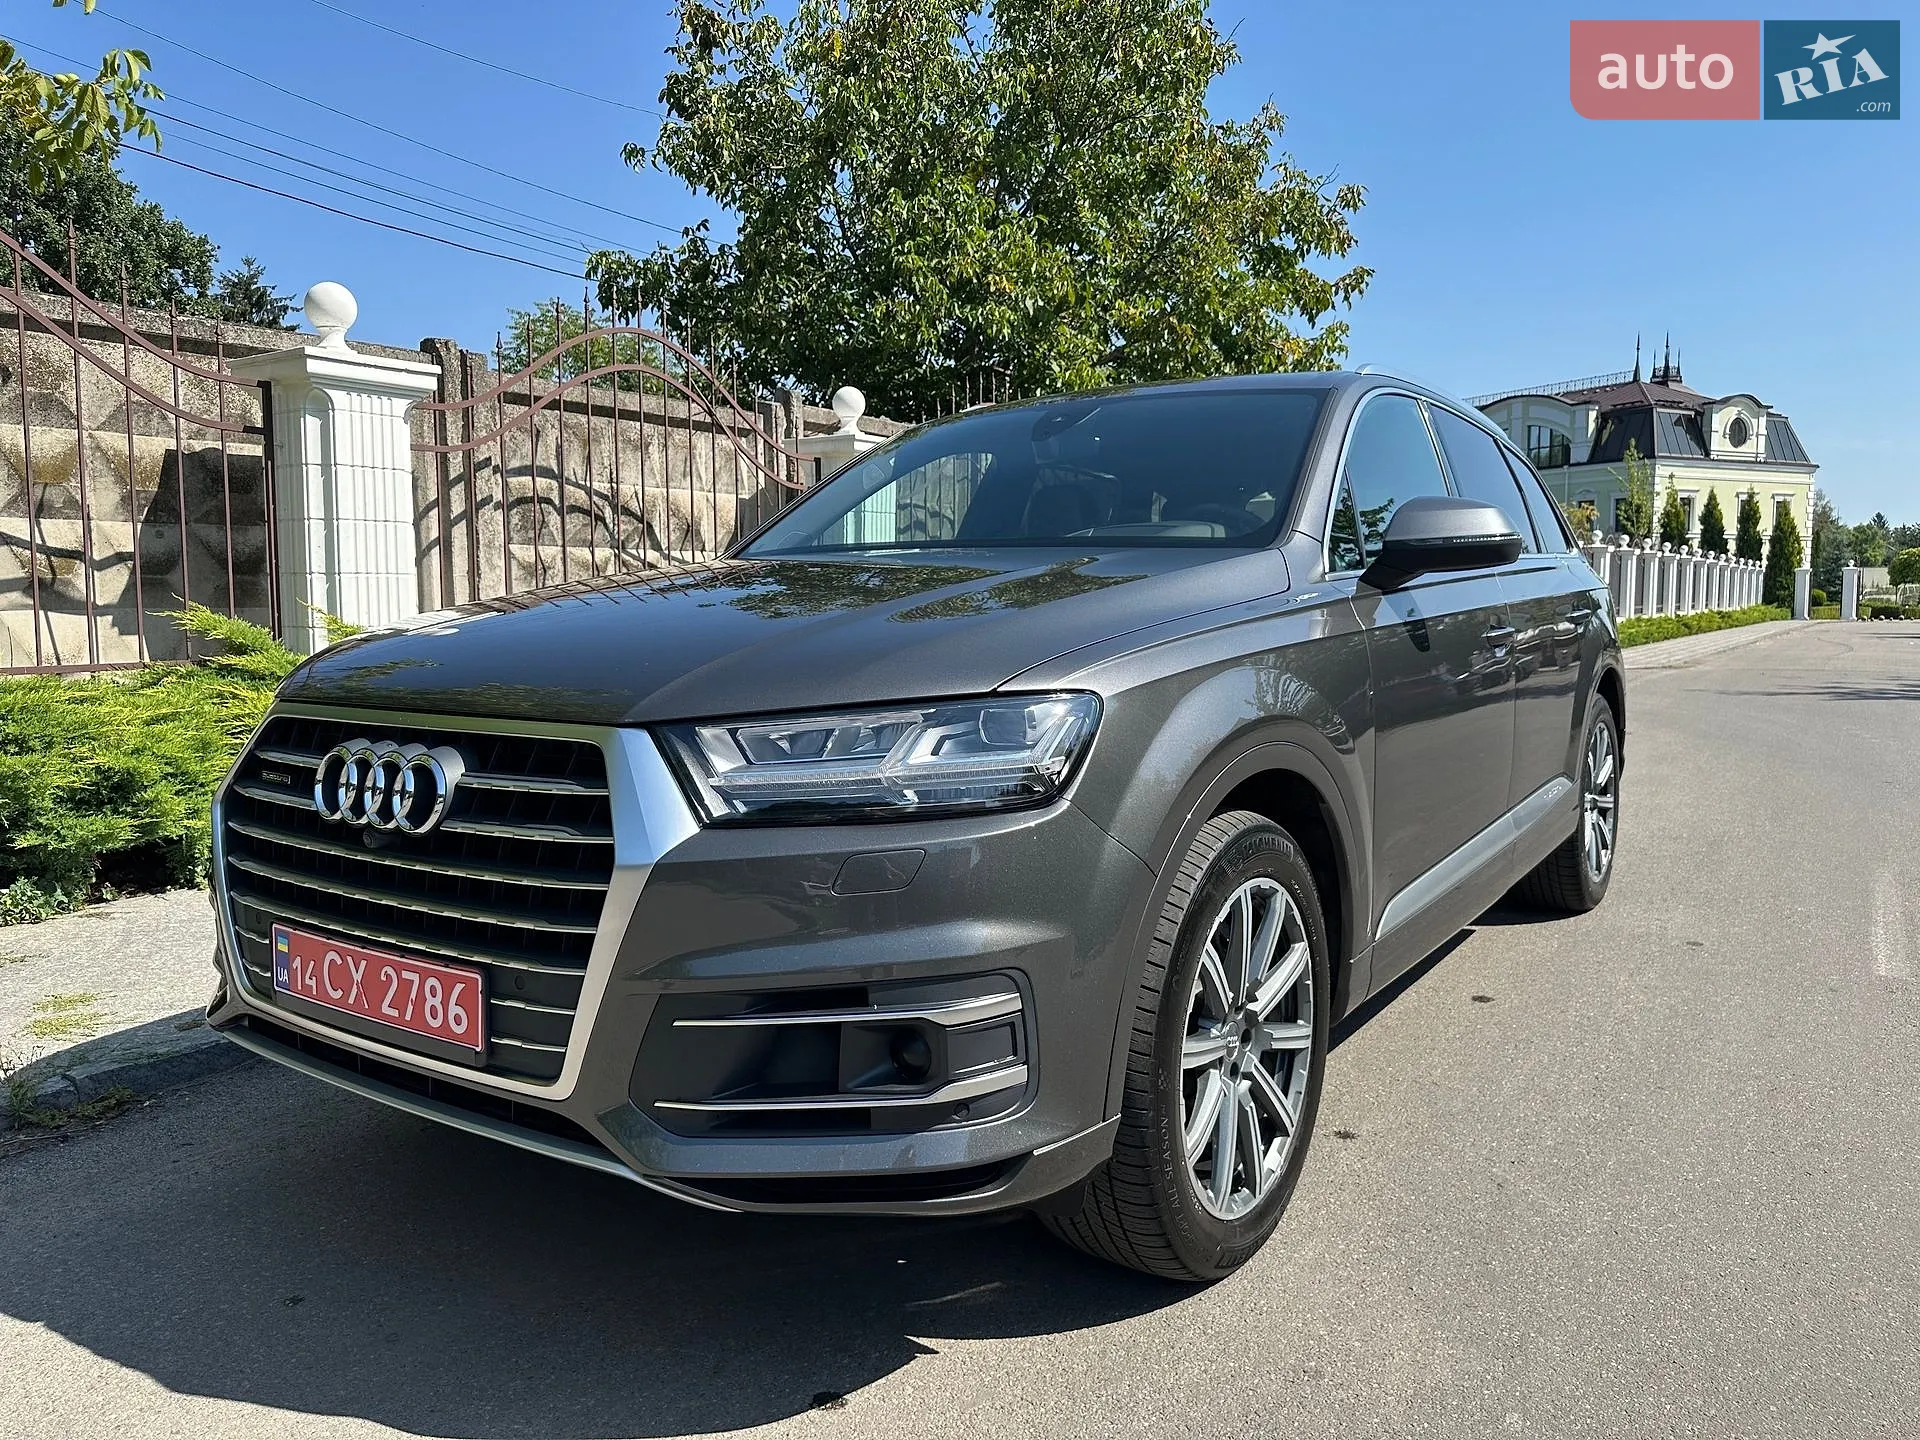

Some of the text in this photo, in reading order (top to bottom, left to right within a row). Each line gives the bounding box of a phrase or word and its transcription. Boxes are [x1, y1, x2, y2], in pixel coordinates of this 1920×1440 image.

[277, 967, 289, 983] UA
[380, 965, 469, 1035] 2786
[1160, 1116, 1174, 1180] SEASON
[1166, 1184, 1182, 1209] ALL
